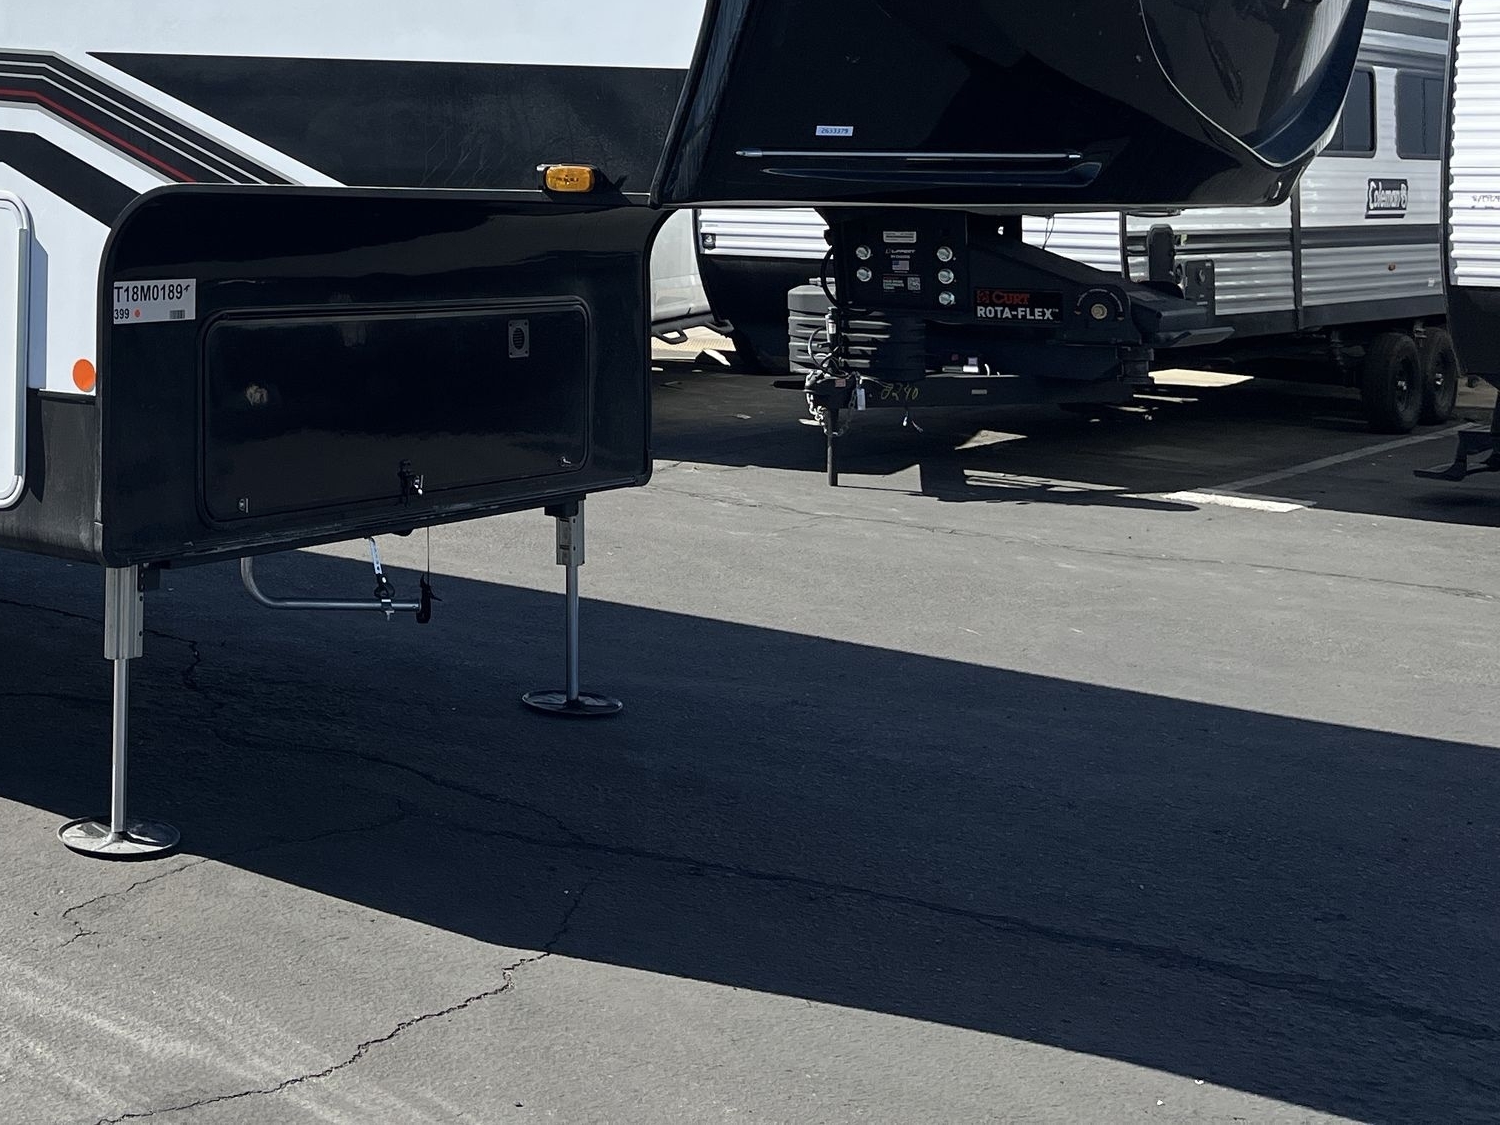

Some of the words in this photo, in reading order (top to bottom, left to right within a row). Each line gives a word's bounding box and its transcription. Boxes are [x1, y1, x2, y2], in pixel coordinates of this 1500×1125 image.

[114, 284, 183, 303] T18M0189
[992, 290, 1030, 305] CURT
[114, 308, 130, 320] 399
